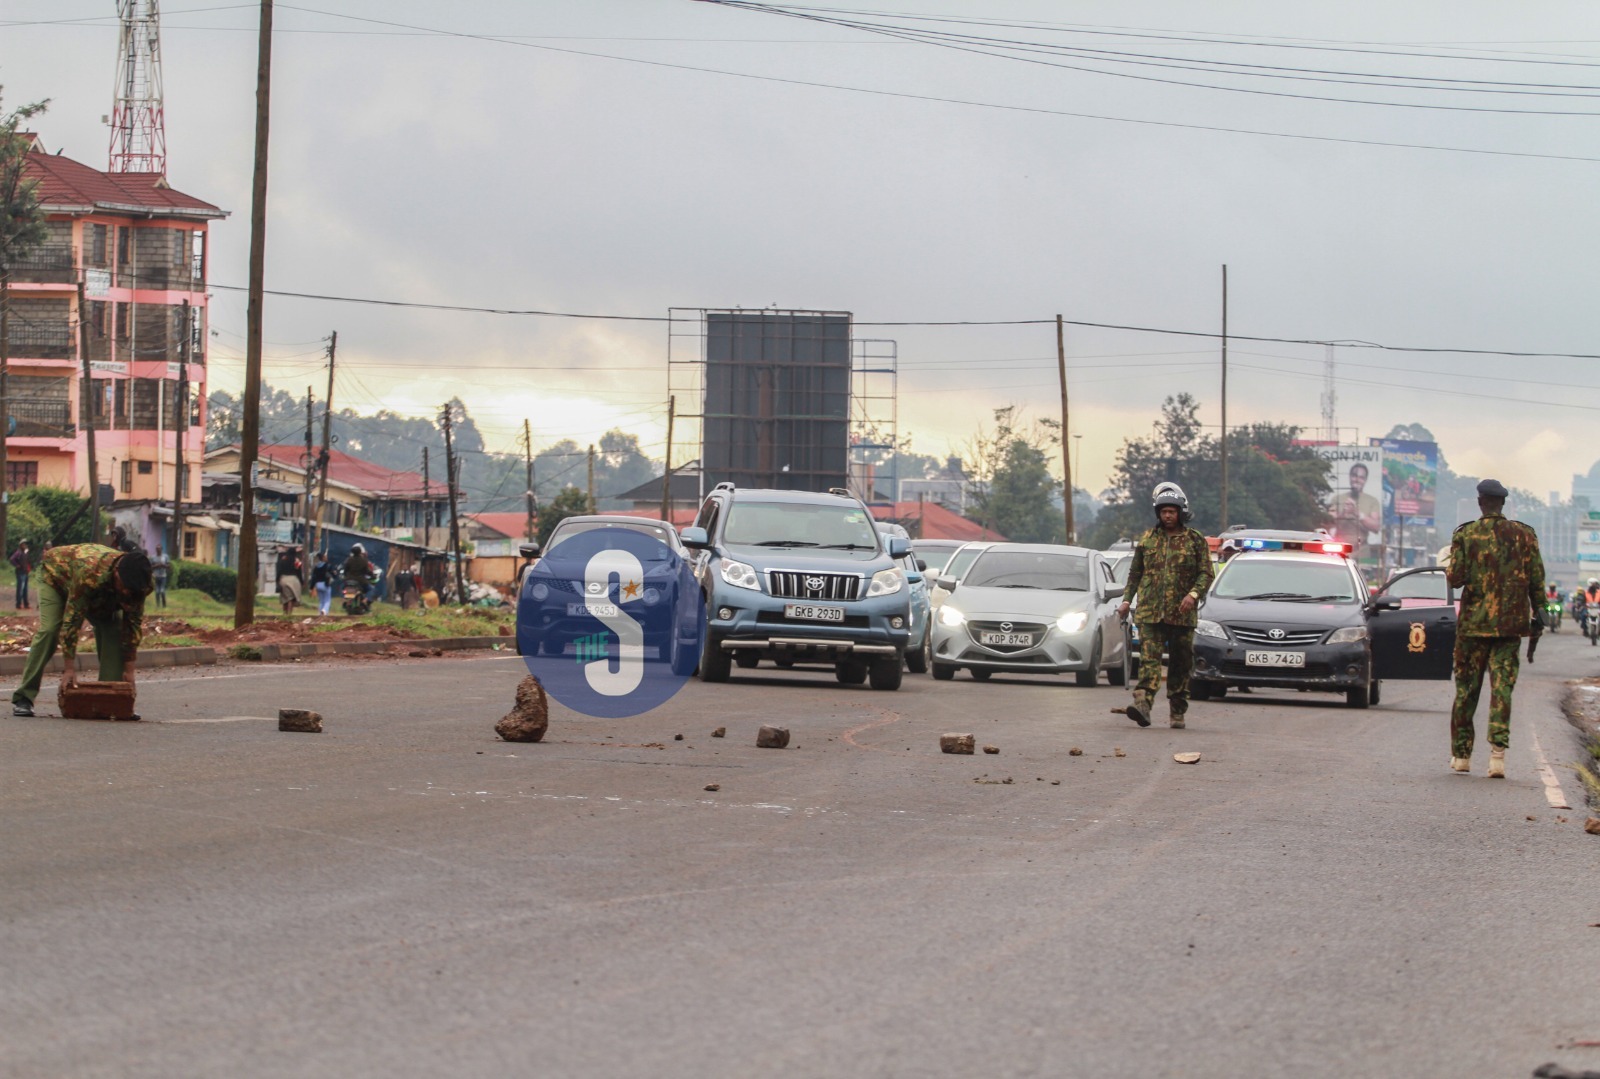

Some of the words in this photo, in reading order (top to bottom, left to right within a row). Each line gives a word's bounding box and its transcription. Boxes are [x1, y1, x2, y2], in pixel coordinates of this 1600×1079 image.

[1353, 450, 1379, 462] HAVI
[1157, 491, 1179, 500] POLICE
[594, 605, 616, 616] 945J
[795, 606, 814, 618] GKB
[817, 608, 841, 620] 293D
[989, 634, 1006, 644] KDP
[1009, 634, 1030, 645] 874R
[1248, 653, 1269, 664] GKB
[1274, 654, 1303, 665] 742D
